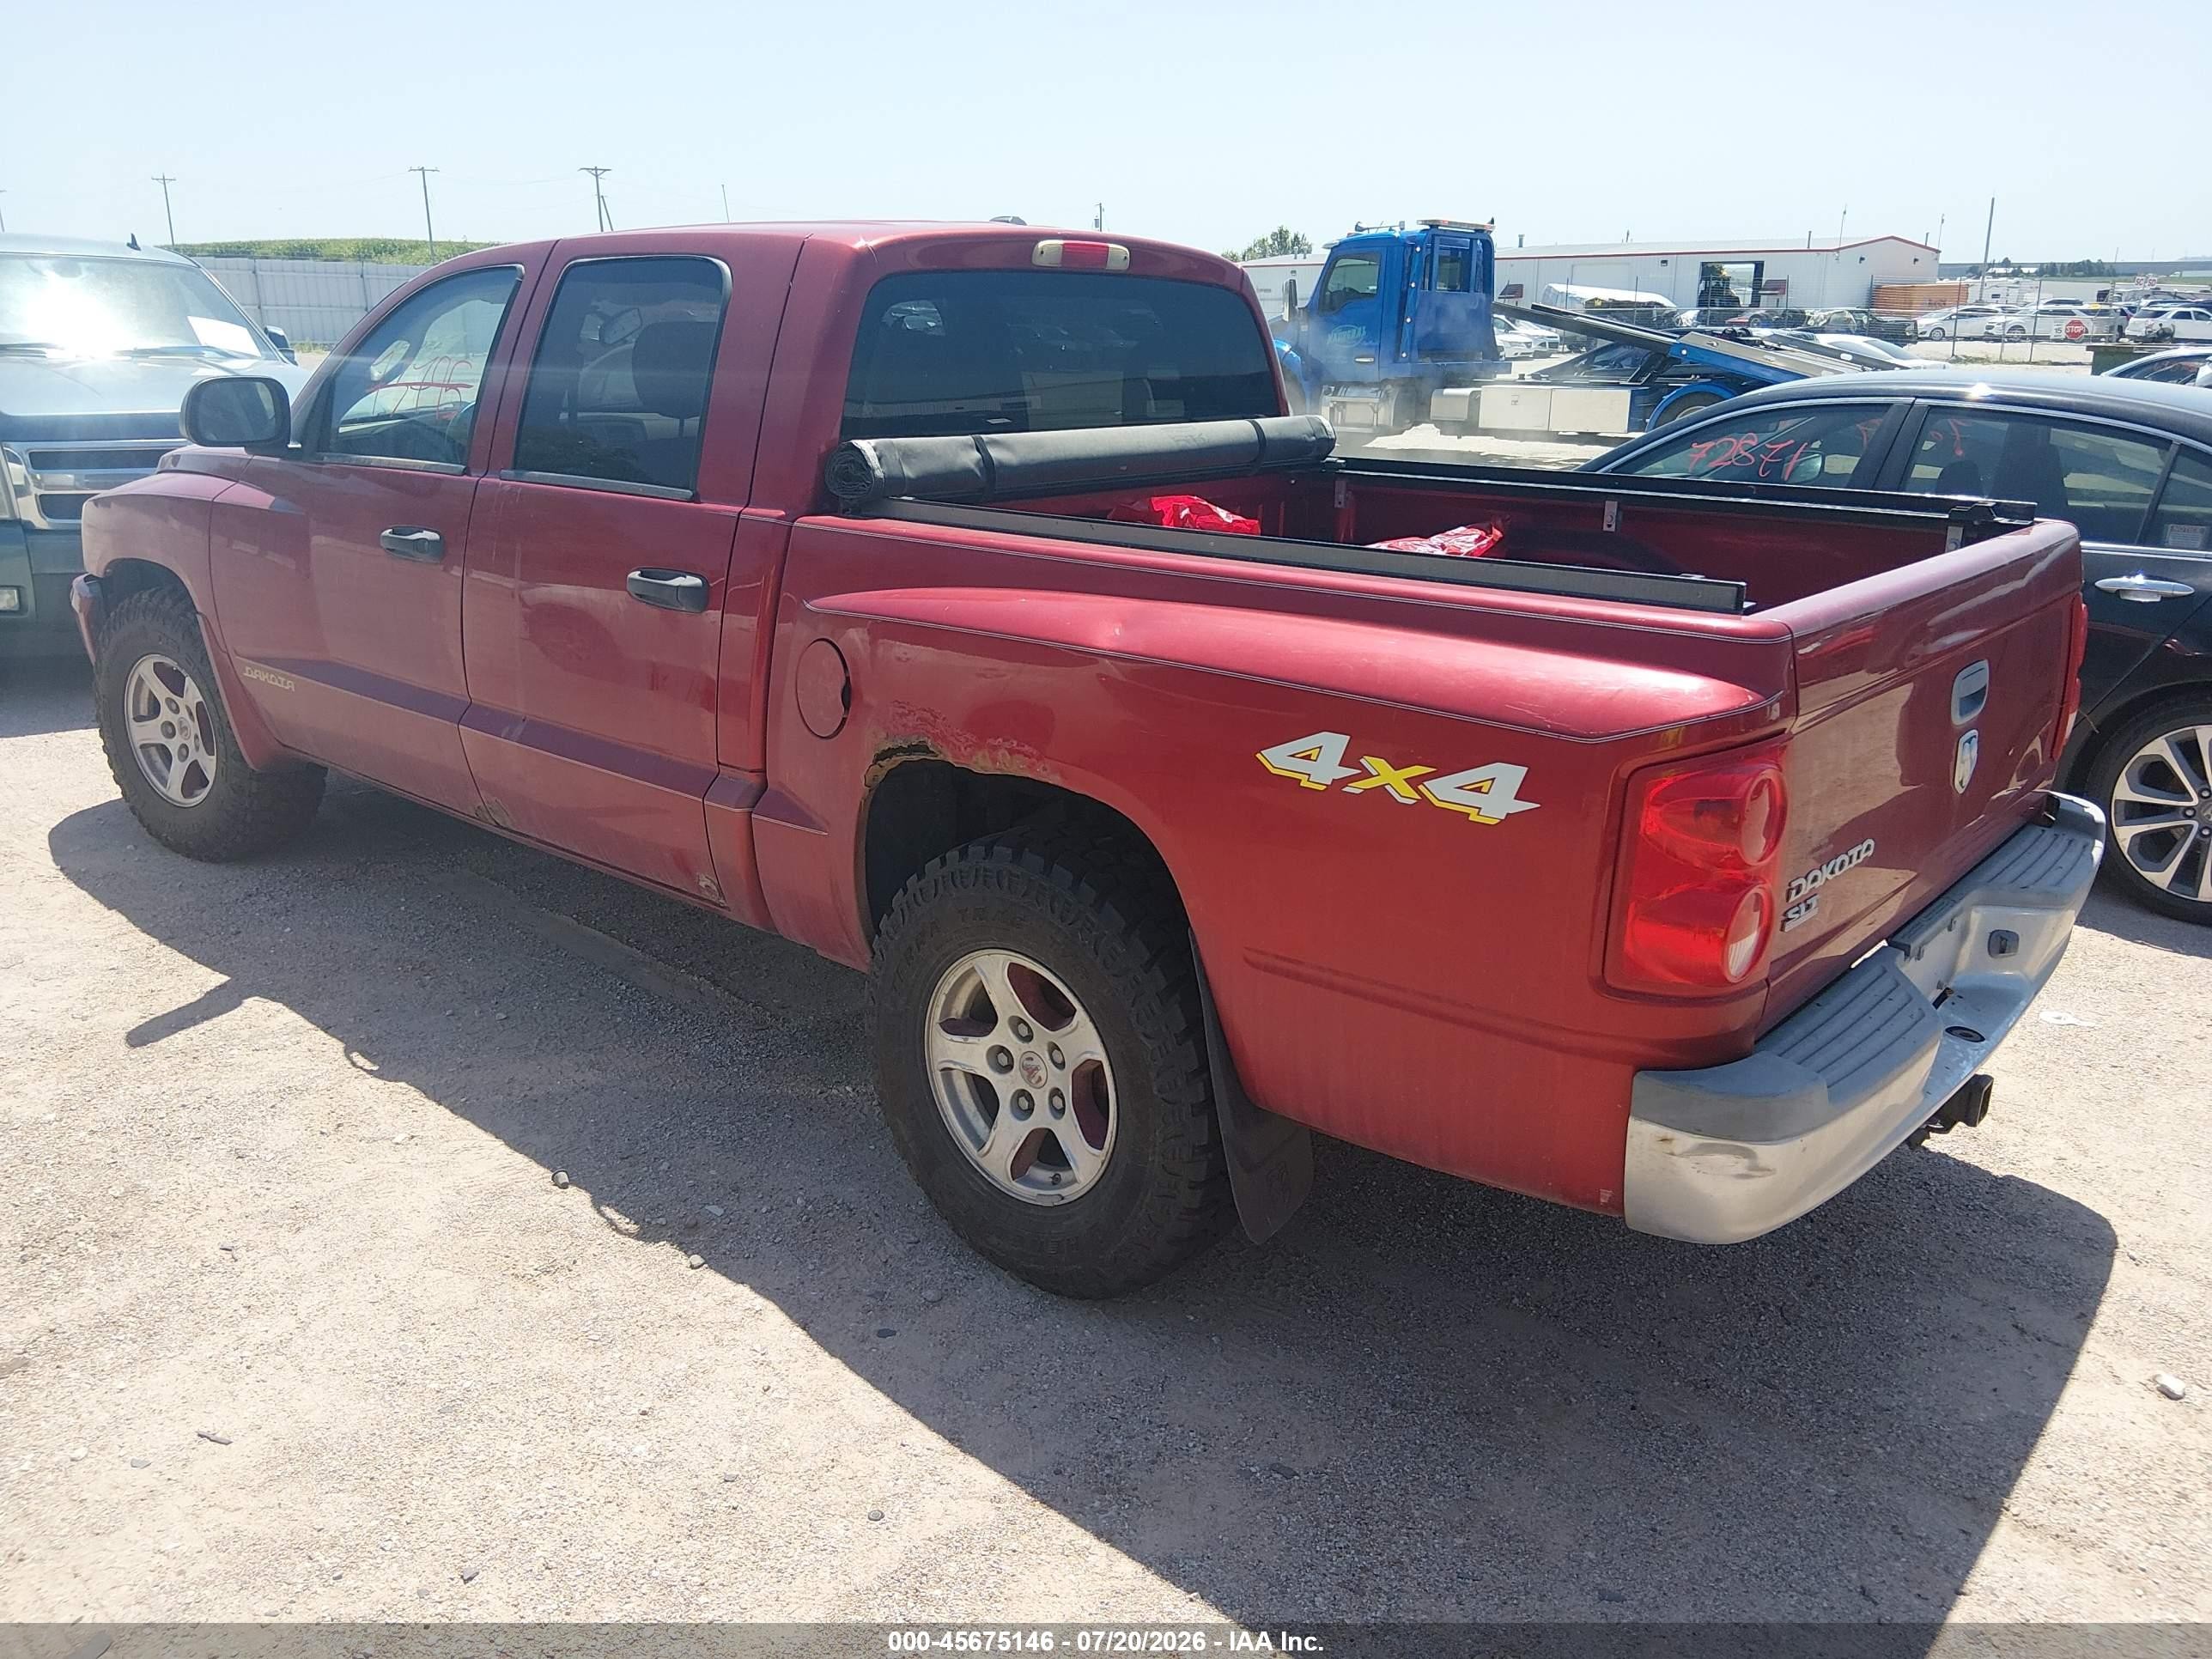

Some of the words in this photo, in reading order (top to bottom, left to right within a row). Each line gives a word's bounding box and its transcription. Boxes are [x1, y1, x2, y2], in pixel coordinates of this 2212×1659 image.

[243, 666, 295, 692] DAKOTA
[1786, 838, 1875, 902] DAKOTA
[1780, 893, 1820, 933] SLT
